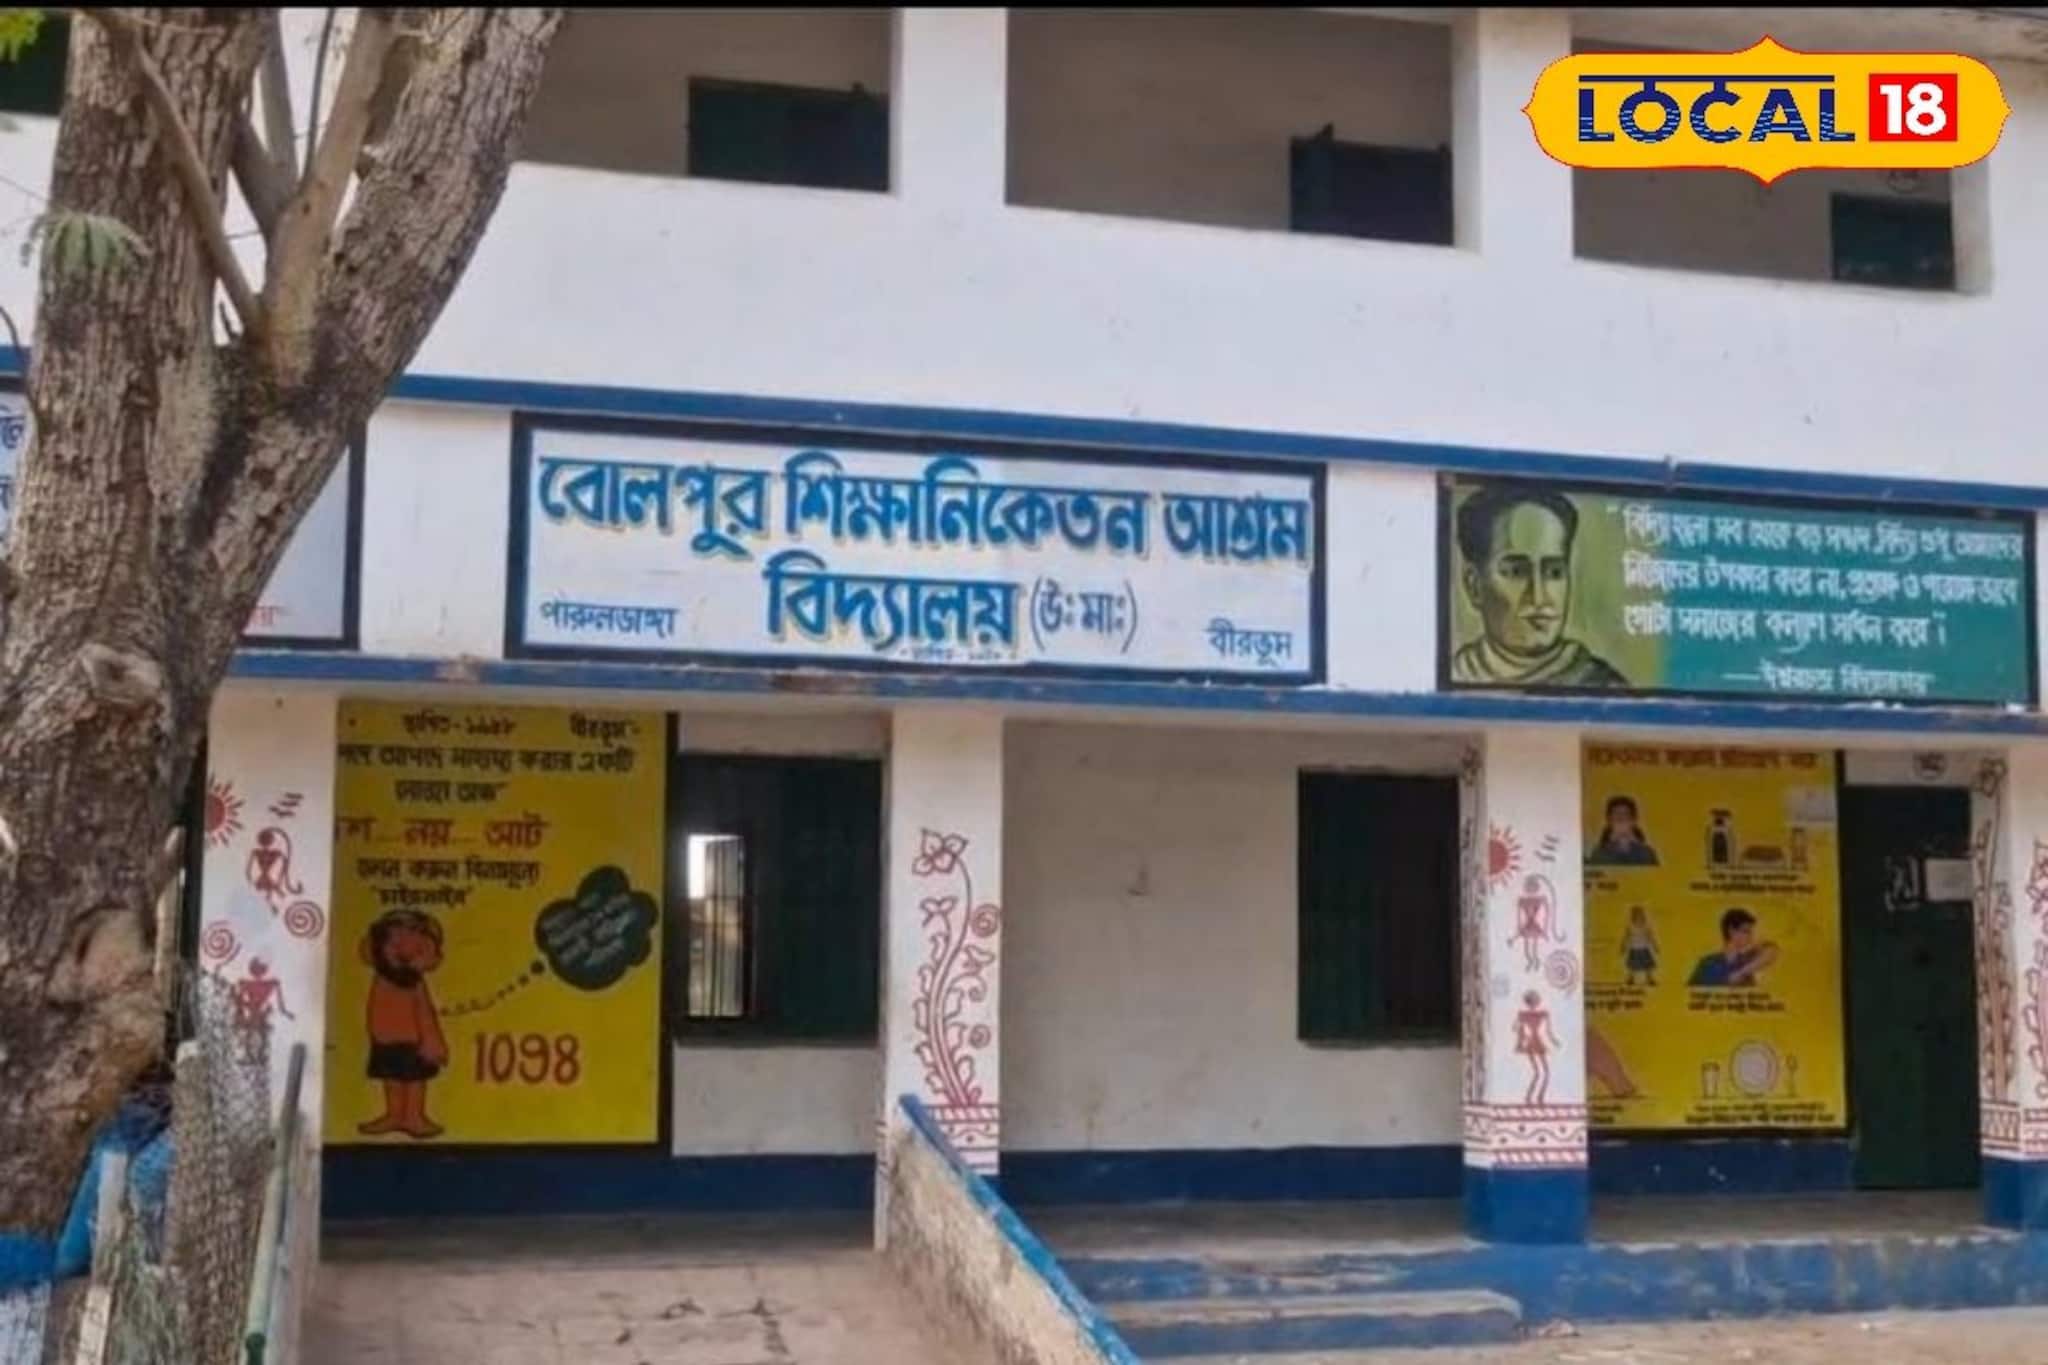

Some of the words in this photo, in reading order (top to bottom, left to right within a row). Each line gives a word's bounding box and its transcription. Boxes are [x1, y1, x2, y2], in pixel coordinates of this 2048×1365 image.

[539, 456, 772, 560] বোলপুর
[785, 450, 1150, 557] শিক্ষানিকেতন
[1162, 491, 1311, 562] আশ্রম
[540, 599, 679, 638] পারুলডাঙ্গা
[762, 550, 1021, 652] বিদ্যালয়
[1206, 617, 1293, 667] বীরভূম
[475, 1032, 579, 1086] 1098
